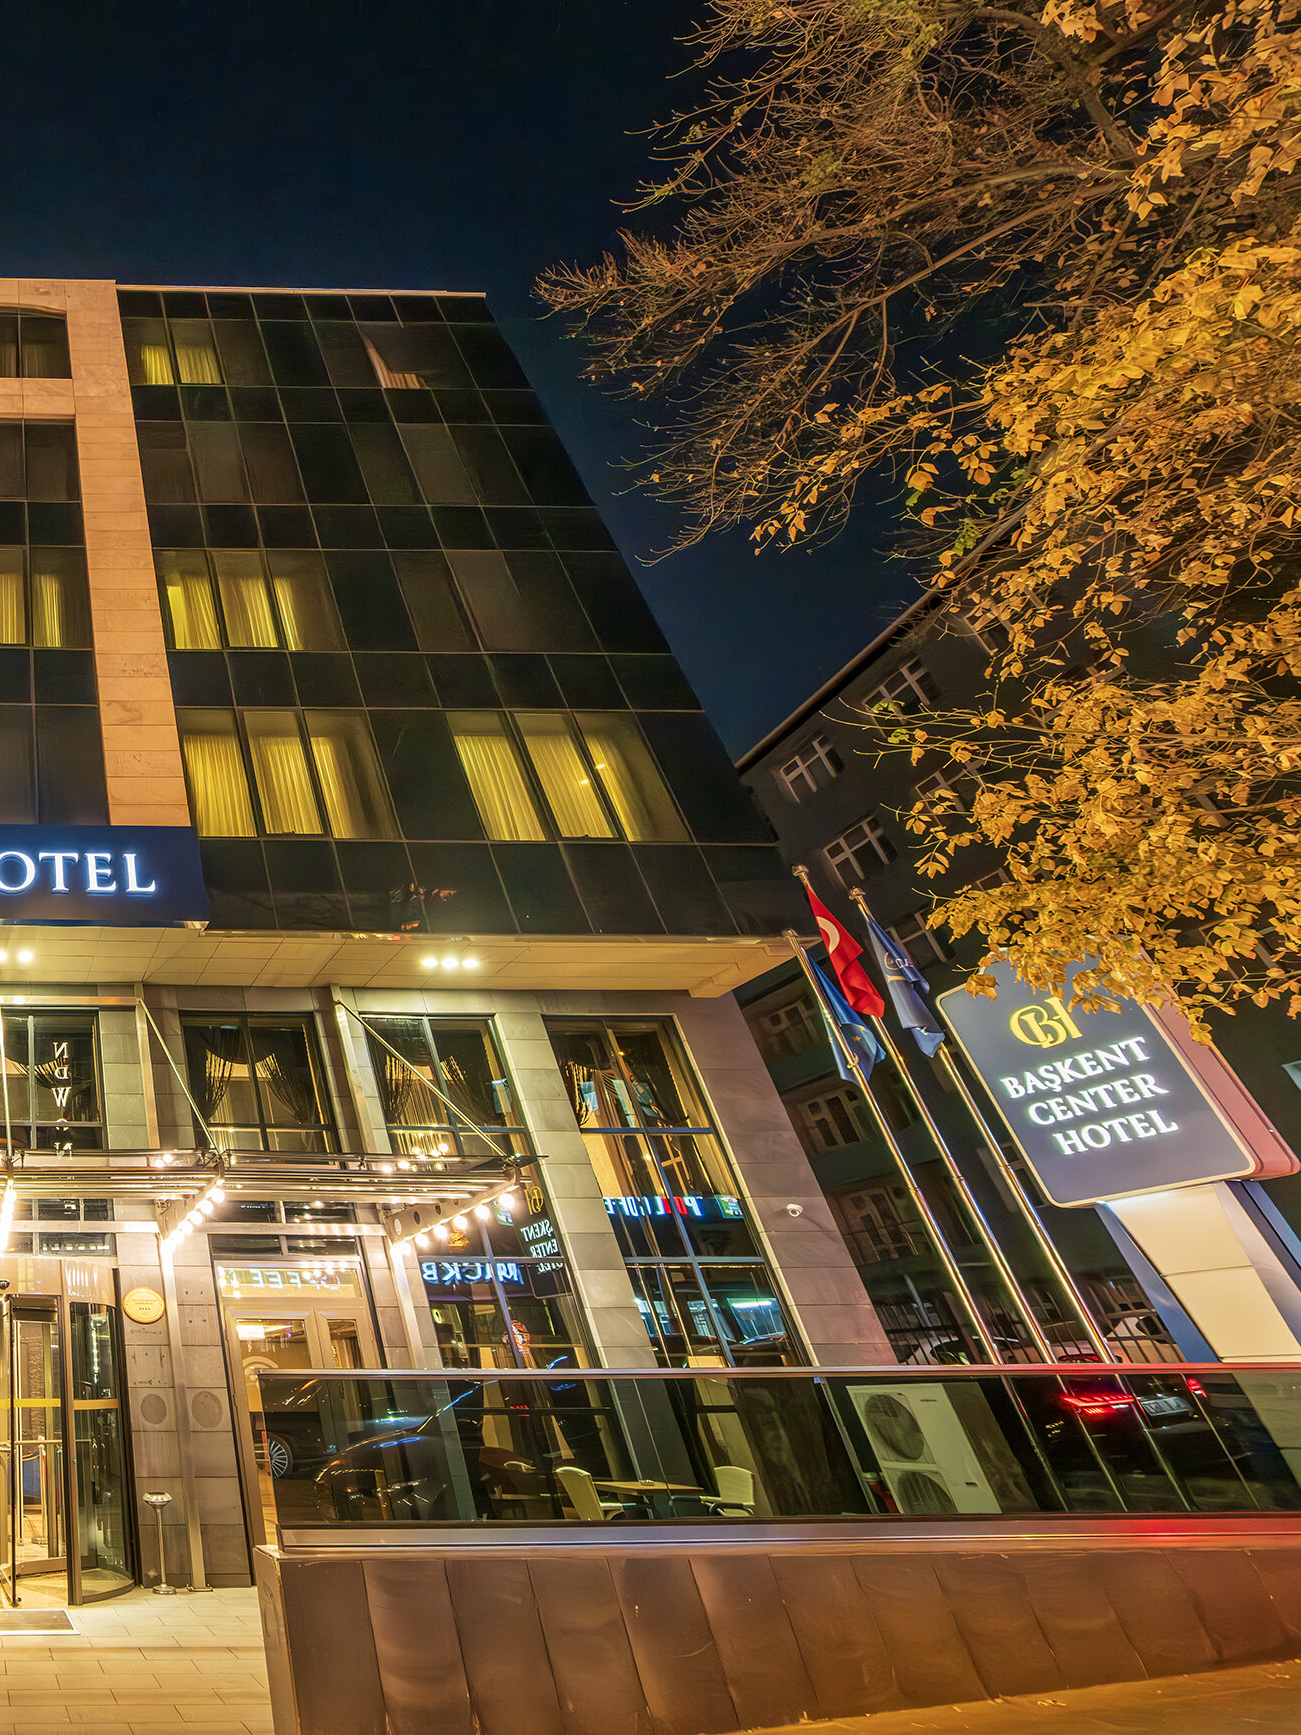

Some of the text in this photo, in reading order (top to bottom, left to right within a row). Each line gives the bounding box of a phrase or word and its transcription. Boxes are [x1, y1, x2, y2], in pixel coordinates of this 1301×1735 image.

[1000, 1036, 1150, 1099] BAŞKENT
[1027, 1072, 1169, 1126] CENTER
[1052, 1109, 1179, 1156] HOTEL
